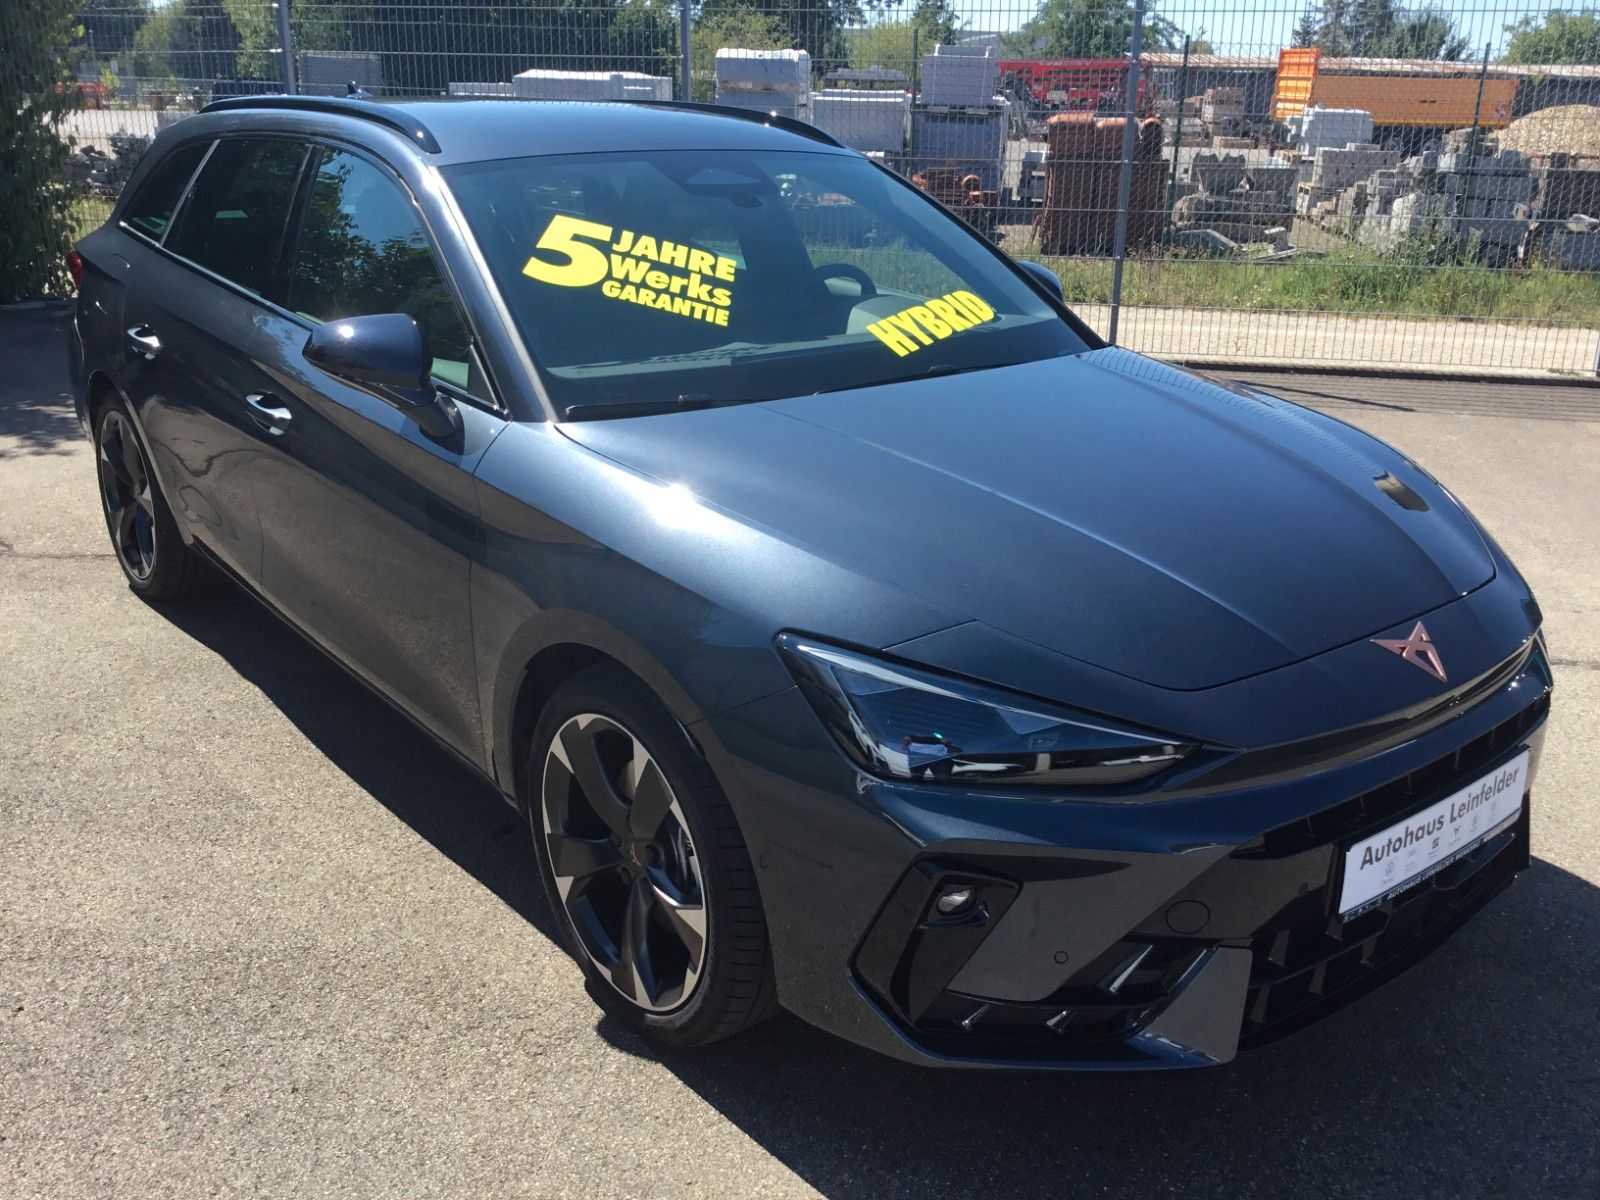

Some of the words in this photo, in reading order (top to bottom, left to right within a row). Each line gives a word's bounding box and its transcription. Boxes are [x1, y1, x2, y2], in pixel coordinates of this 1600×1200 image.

[522, 214, 613, 287] 5
[612, 230, 737, 282] JAHRE
[610, 253, 732, 307] Werks
[602, 280, 730, 327] GARANTIE
[866, 290, 995, 357] HYBRID
[1360, 814, 1445, 870] Autohaus
[1450, 768, 1519, 824] Leinfelder
